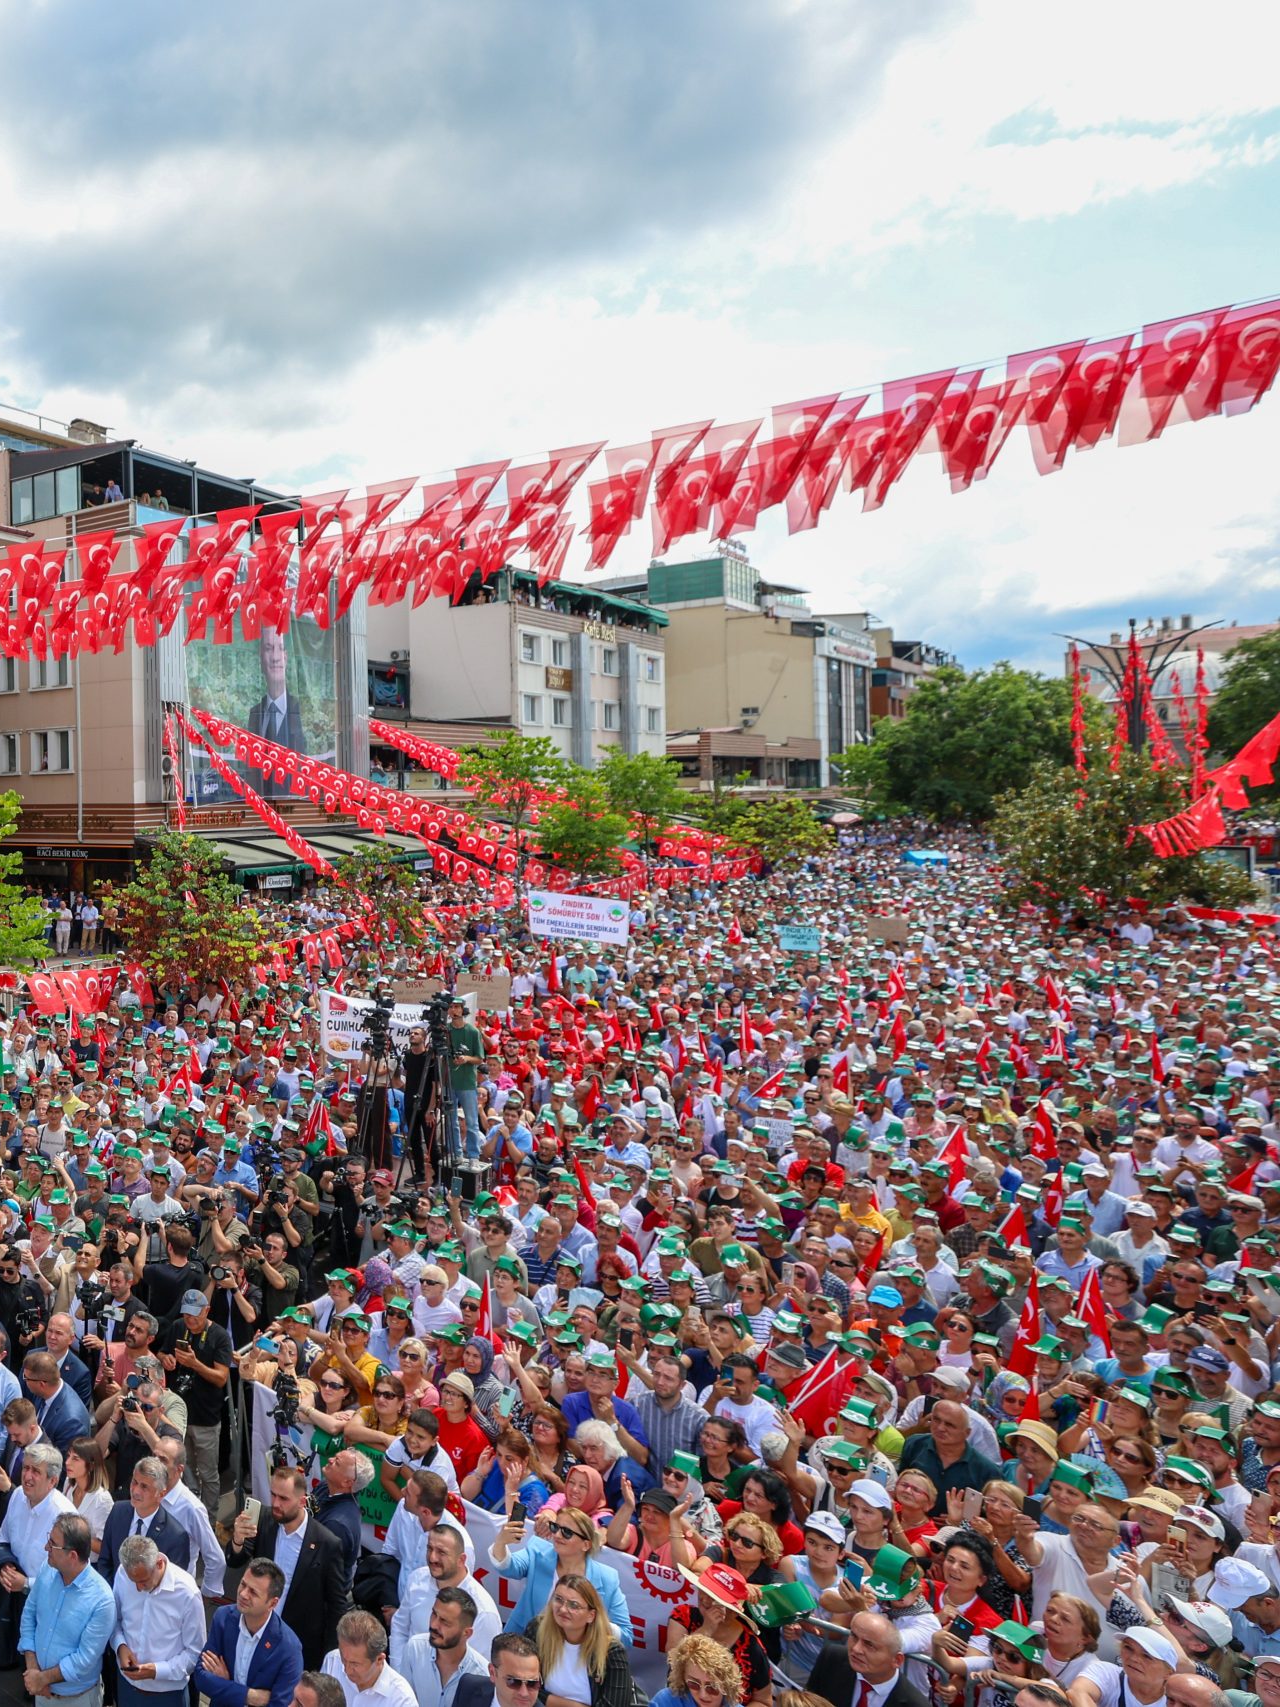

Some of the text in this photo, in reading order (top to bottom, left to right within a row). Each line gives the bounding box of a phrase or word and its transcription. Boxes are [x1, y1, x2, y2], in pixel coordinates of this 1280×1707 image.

[561, 899, 593, 910] FINDIKTA
[548, 907, 584, 919] SÖMÜRÜYE
[586, 912, 600, 921] SON
